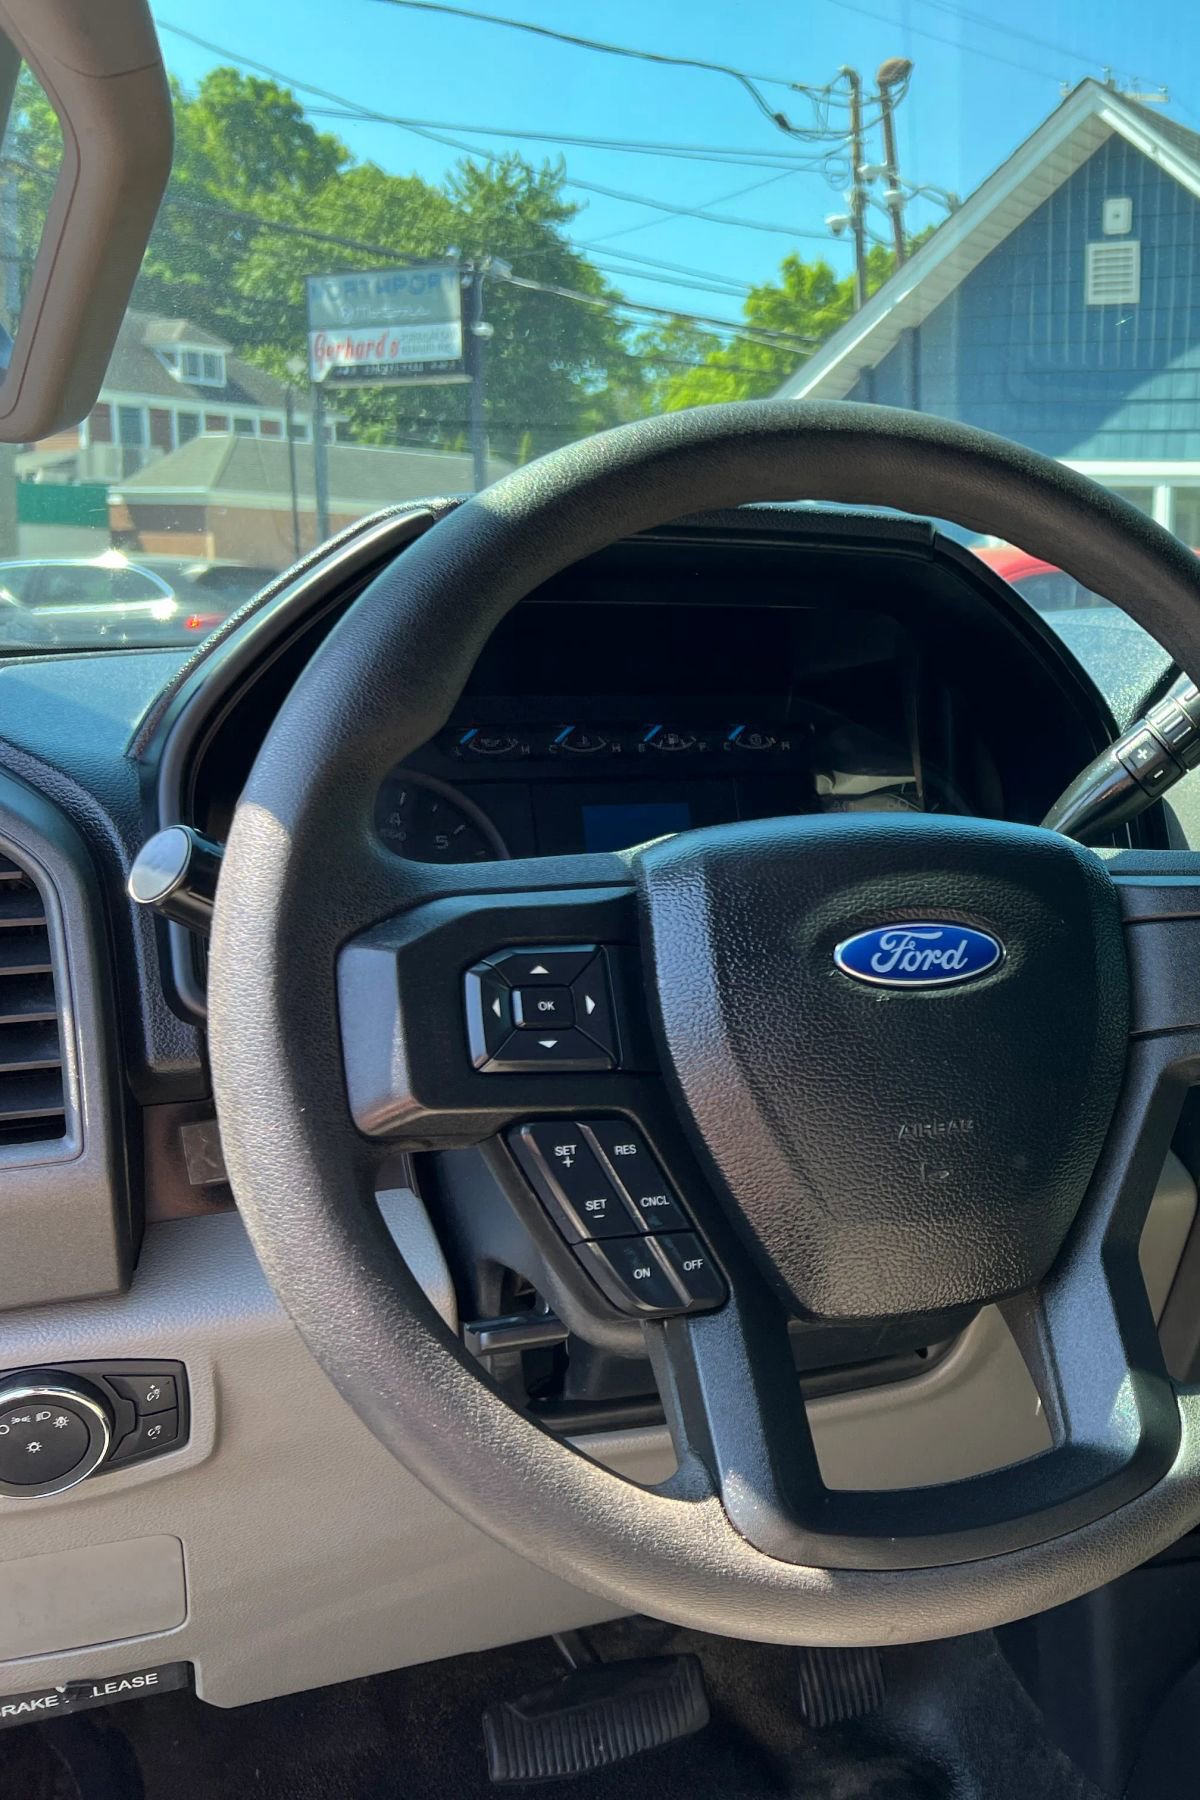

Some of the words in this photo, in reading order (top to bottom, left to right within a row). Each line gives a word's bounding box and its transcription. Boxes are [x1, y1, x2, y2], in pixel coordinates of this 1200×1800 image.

[435, 834, 449, 849] 5
[871, 931, 968, 973] Ford
[537, 1001, 556, 1012] OK
[555, 1145, 576, 1157] SET
[614, 1144, 637, 1156] RES
[585, 1199, 607, 1211] SET
[641, 1195, 670, 1208] CNCL
[683, 1259, 704, 1271] OFF
[633, 1268, 651, 1280] ON
[0, 1695, 59, 1718] RAKE
